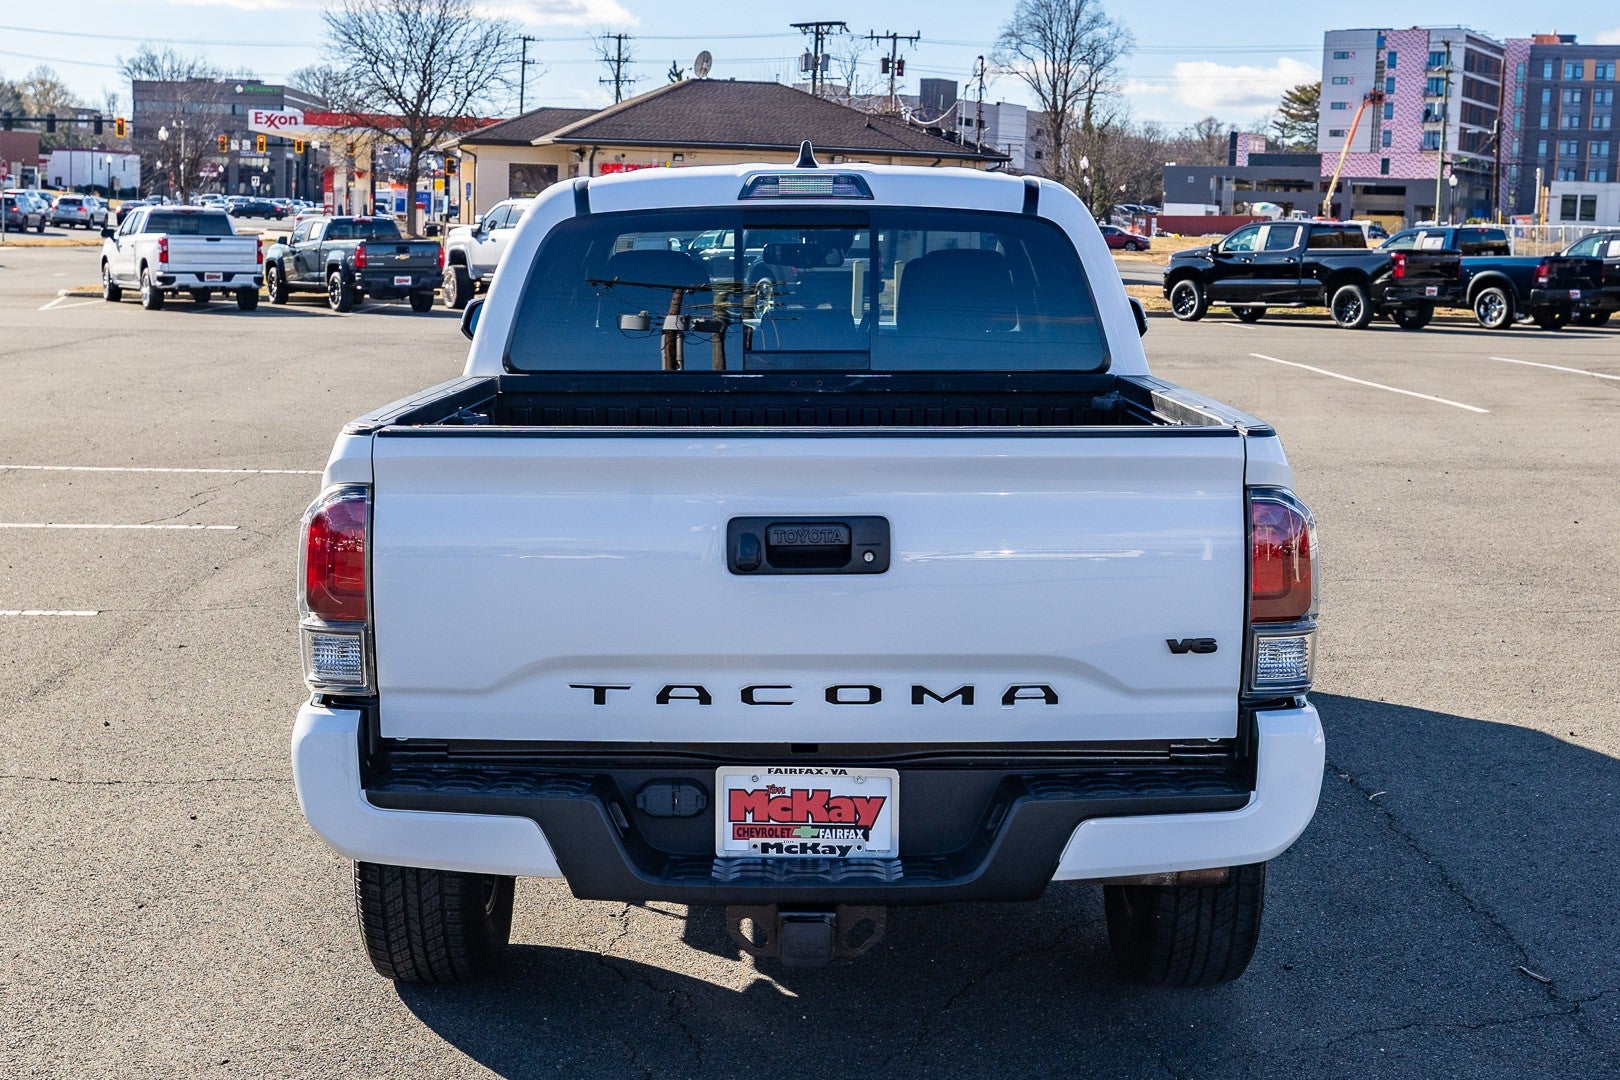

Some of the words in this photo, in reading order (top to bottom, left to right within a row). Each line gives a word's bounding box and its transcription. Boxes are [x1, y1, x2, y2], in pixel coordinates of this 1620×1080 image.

[254, 112, 298, 129] Exxon
[774, 529, 844, 543] TOYOTA
[1166, 637, 1218, 654] V6
[568, 684, 1059, 705] TACOMA
[728, 788, 887, 830] McKay
[736, 826, 791, 838] CHEVROLET
[819, 828, 864, 839] FAIRFAX
[760, 842, 853, 858] McKay
